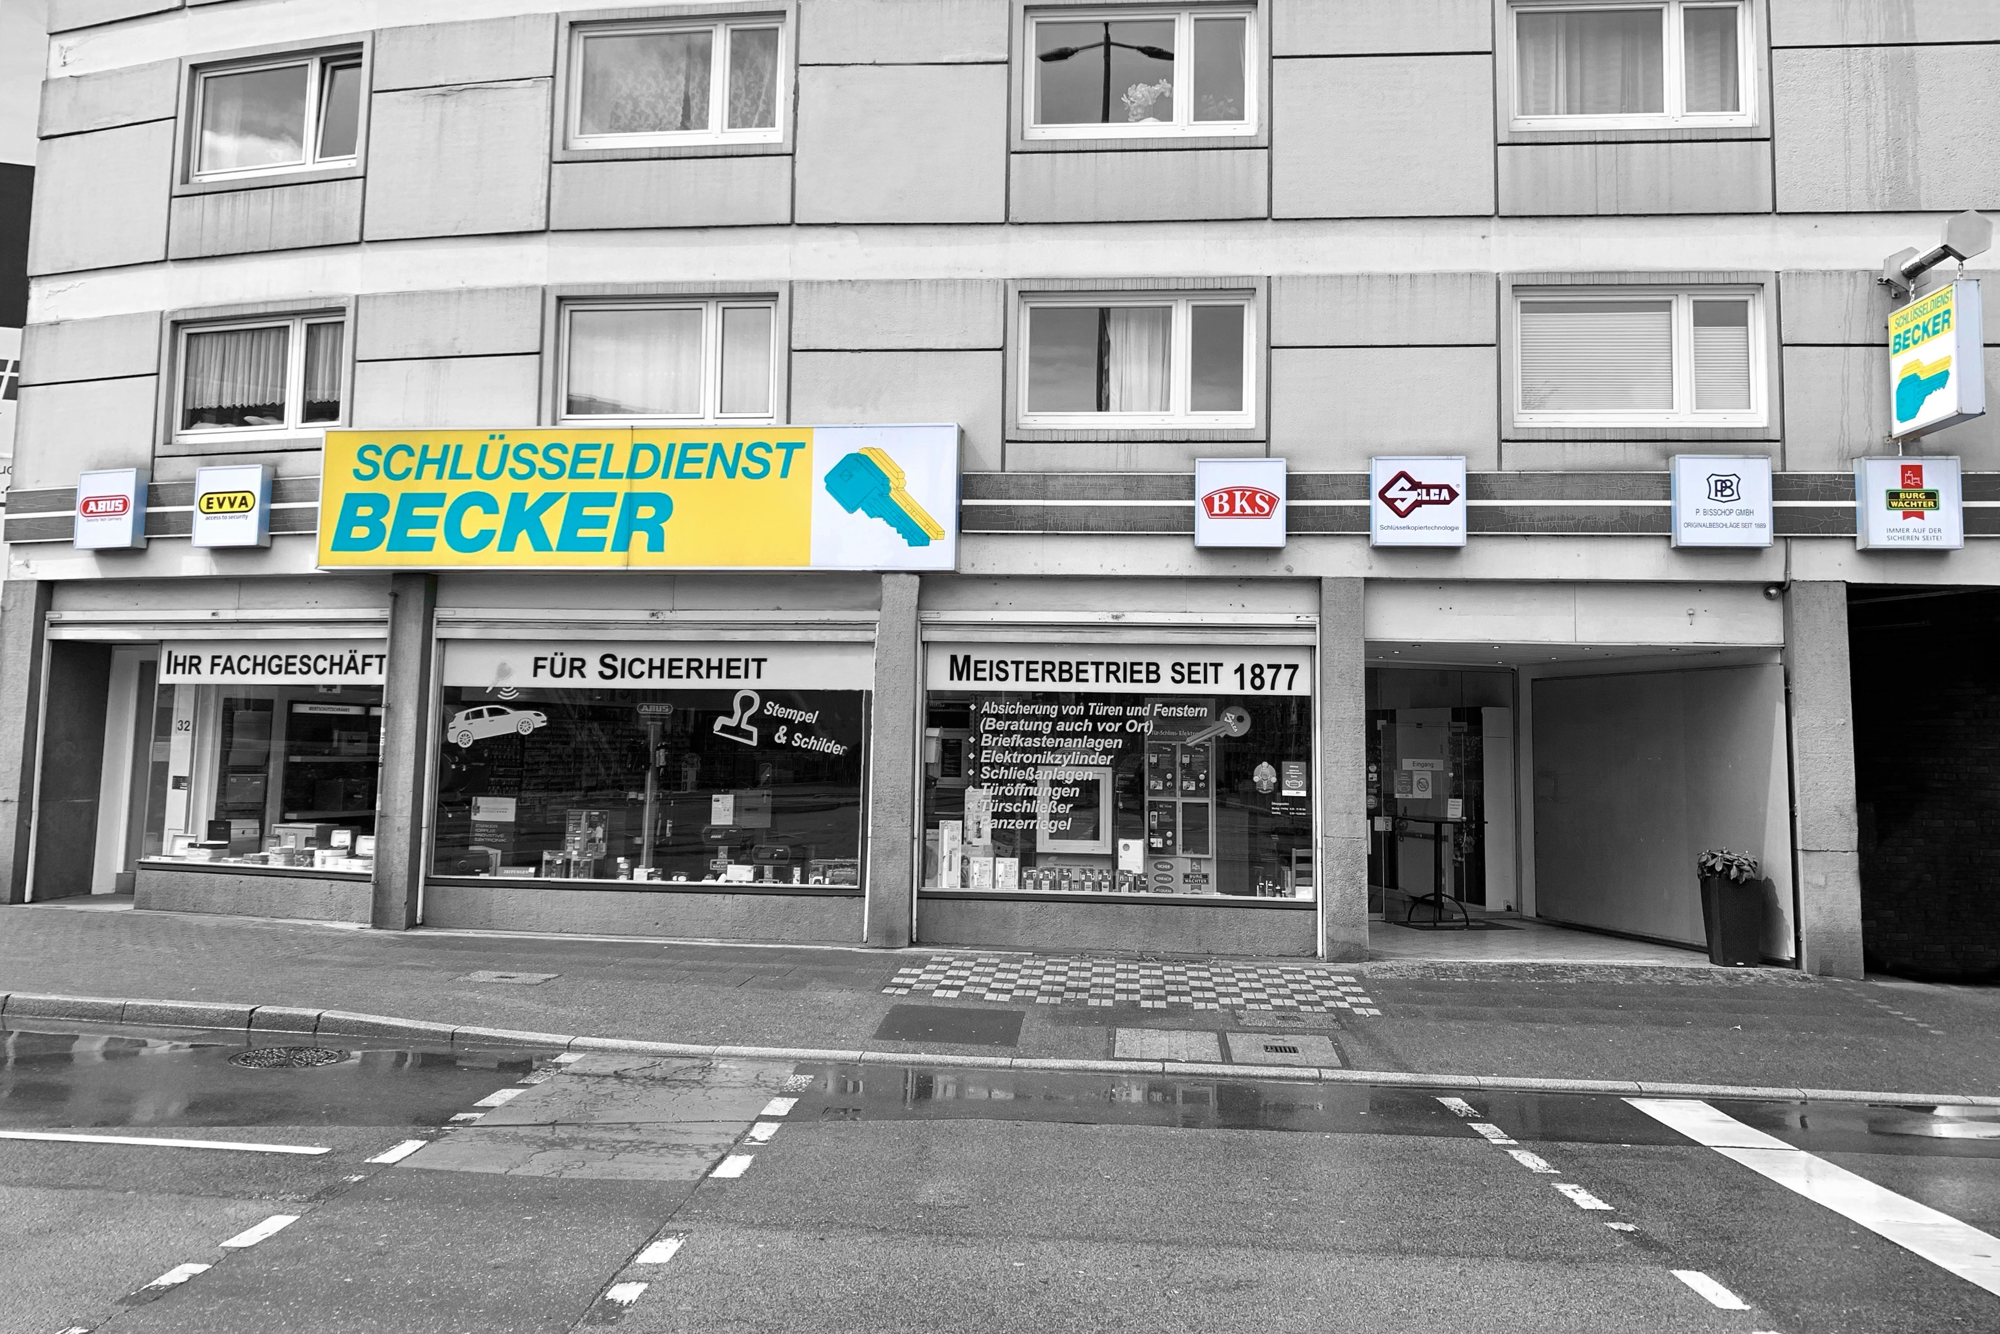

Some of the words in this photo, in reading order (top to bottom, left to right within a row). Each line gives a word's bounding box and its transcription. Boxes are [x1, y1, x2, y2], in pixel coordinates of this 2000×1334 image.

[1892, 308, 1952, 355] BECKER
[352, 434, 806, 481] SCHLÜSSELDIENST
[86, 499, 124, 513] ABUS
[205, 495, 249, 510] EVVA
[1210, 489, 1271, 516] BKS
[330, 489, 674, 554] BECKER
[1734, 508, 1755, 517] GMBH
[165, 650, 202, 675] IHR
[209, 649, 387, 676] FACHGESCHÄFT
[532, 652, 587, 679] FÜR
[597, 653, 768, 680] SICHERHEIT
[949, 654, 1161, 684] MEISTERBETRIEB
[1170, 662, 1224, 685] SEIT
[1233, 663, 1300, 691] 1877
[763, 701, 820, 724] Stempel
[980, 701, 1058, 718] Absicherung
[1061, 704, 1085, 717] von
[1088, 702, 1122, 717] Türen
[1126, 703, 1151, 717] und
[1153, 703, 1209, 718] Fenstern
[177, 719, 191, 732] 32
[979, 717, 1052, 734] (Beratung
[1056, 719, 1093, 733] auch
[1096, 721, 1122, 733] vor
[1125, 720, 1154, 736] Ort)
[774, 725, 788, 745] &
[791, 732, 849, 756] Schilder
[980, 733, 1123, 750] Briefkastenanlagen
[980, 749, 1115, 768] Elektronikzylinder
[1412, 761, 1435, 769] Eingang
[980, 765, 1094, 784] Schließanlagen
[980, 781, 1080, 800] Türöffnungen
[981, 799, 1074, 814] Türschließer
